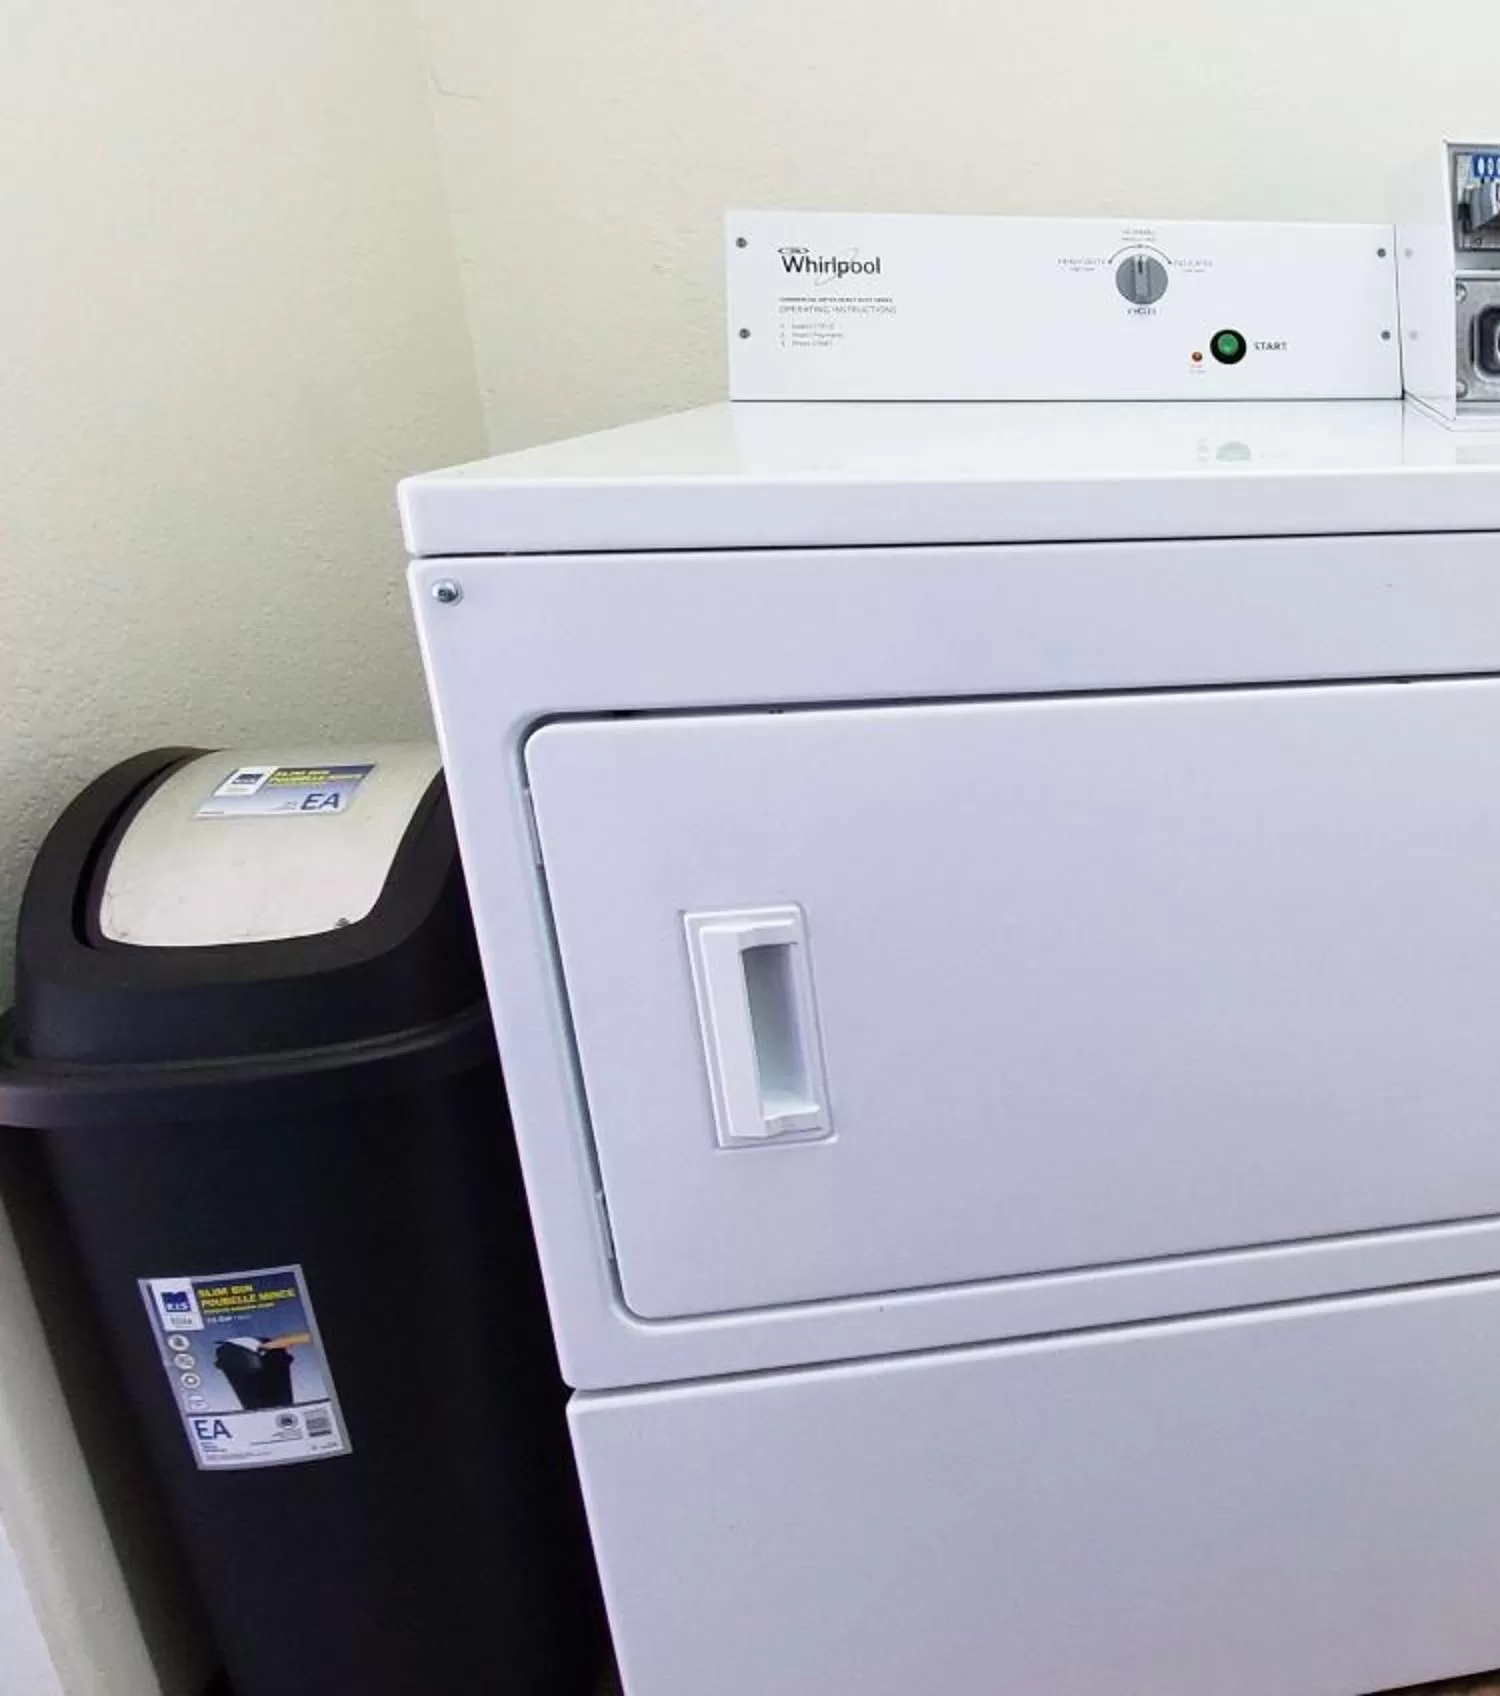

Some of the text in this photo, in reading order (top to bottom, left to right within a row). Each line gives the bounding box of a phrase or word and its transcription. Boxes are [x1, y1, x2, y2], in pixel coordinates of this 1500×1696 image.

[781, 255, 882, 279] Whirlpool
[1254, 341, 1287, 351] START
[300, 792, 341, 811] EA
[193, 1418, 233, 1441] EA
